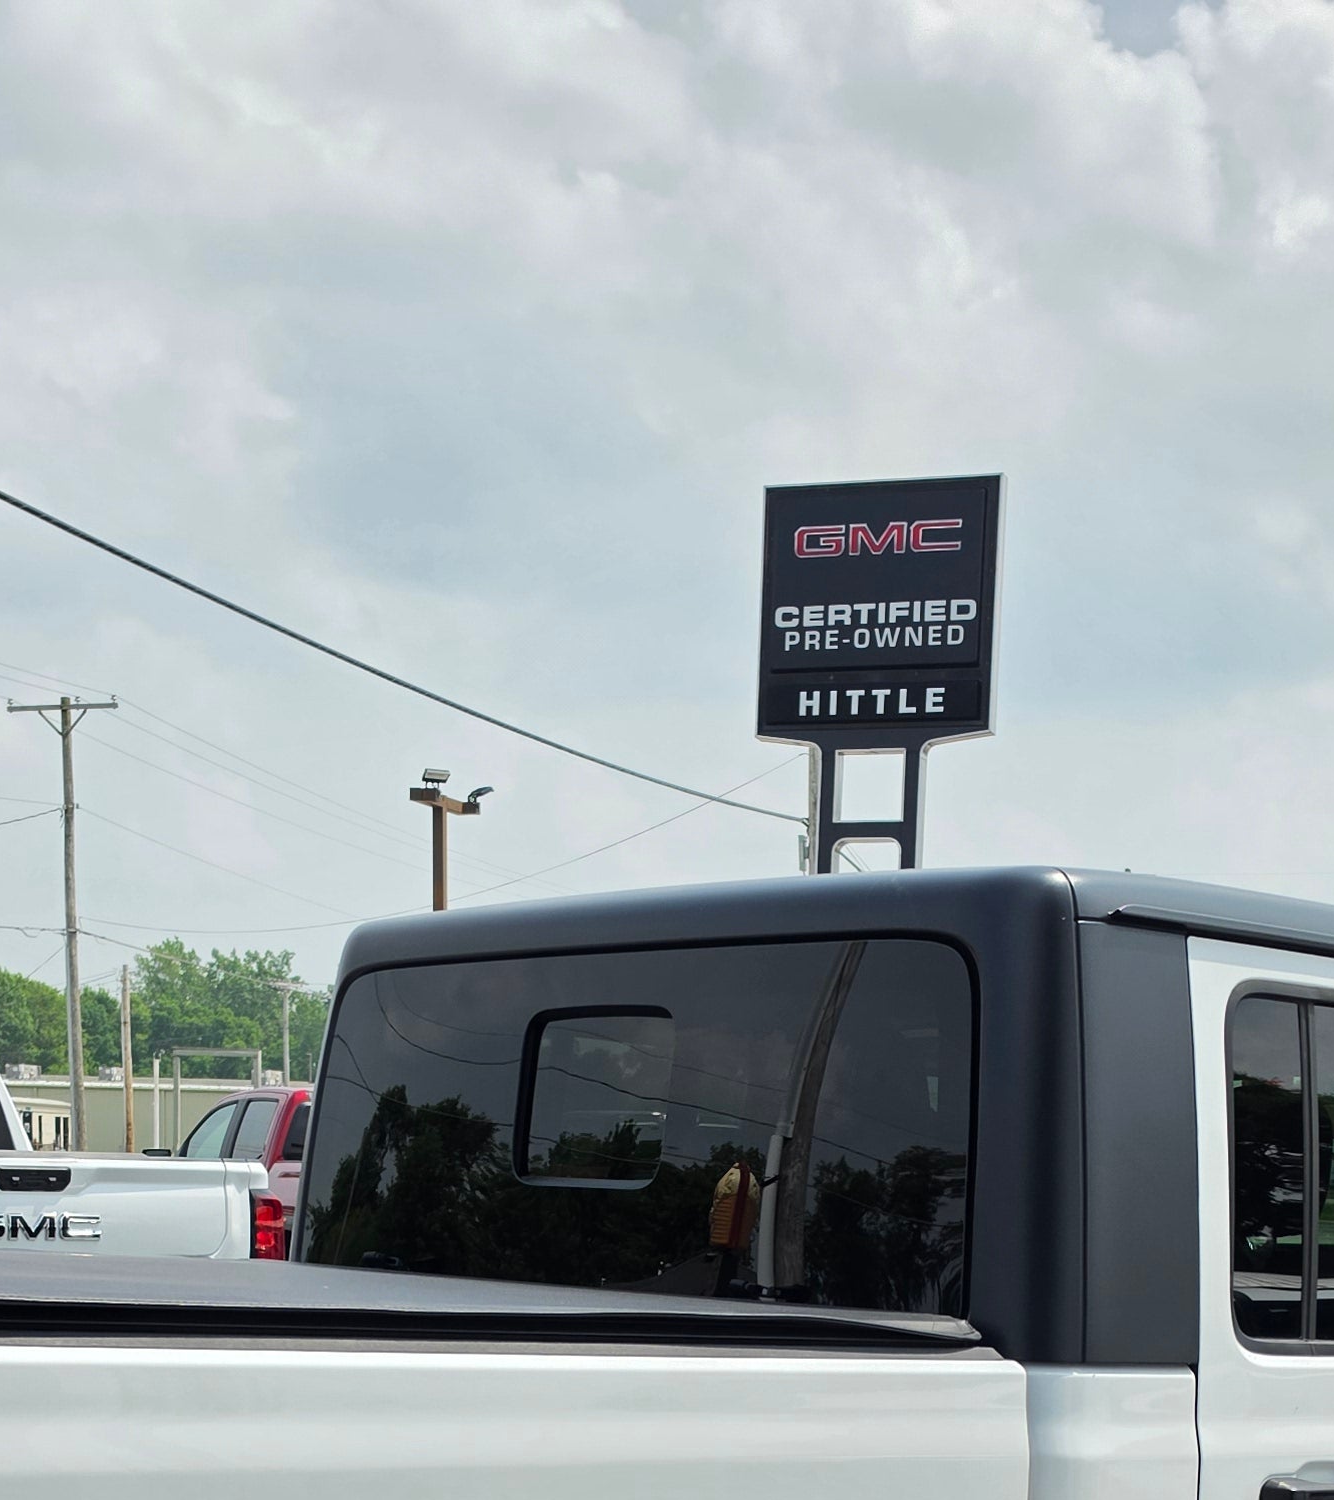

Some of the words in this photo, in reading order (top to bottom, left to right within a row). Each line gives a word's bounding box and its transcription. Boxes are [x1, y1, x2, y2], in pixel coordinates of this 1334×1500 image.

[794, 518, 963, 558] GMC
[774, 599, 977, 628] CERTIFIED
[784, 625, 965, 651] PRE-OWNED
[798, 687, 946, 716] HITTLE
